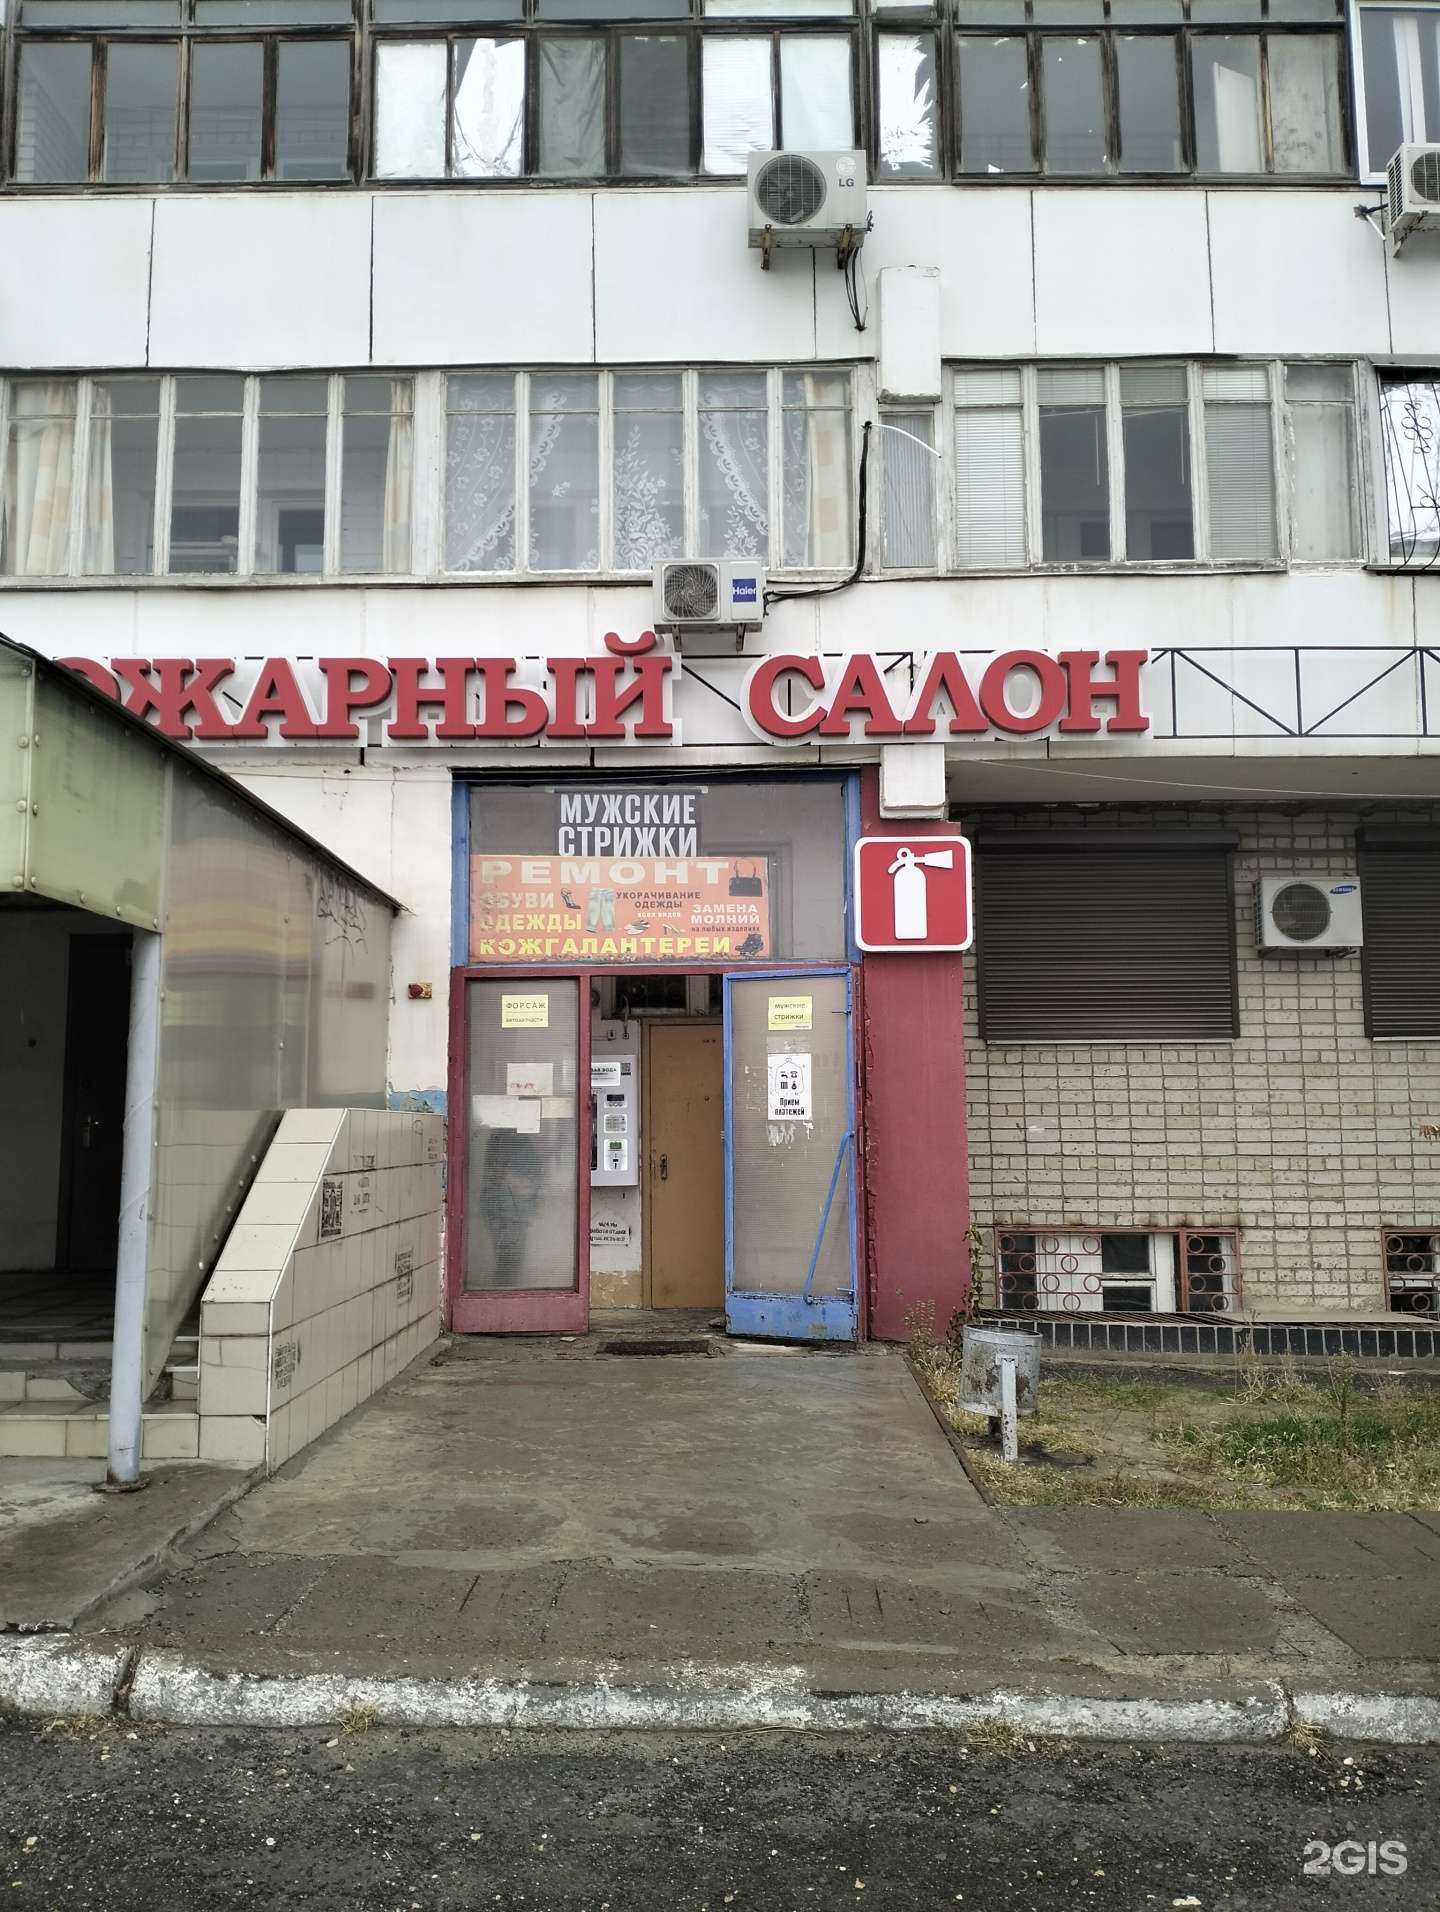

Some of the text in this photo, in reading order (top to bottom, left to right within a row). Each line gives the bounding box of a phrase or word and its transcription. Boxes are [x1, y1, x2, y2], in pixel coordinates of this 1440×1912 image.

[839, 178, 854, 187] LG
[732, 586, 757, 595] Haier
[747, 649, 1150, 737] САЛОН
[560, 794, 696, 825] МУЖСКИЕ
[558, 826, 697, 858] СТРИЖКИ
[481, 861, 729, 885] РЕМОНТ
[616, 891, 701, 900] УКОРАЧИВАНИЕ
[634, 901, 683, 909] ОДЕЖДЫ
[692, 903, 759, 914] ЗАМЕНА
[691, 913, 760, 924] МОЛНИЙ
